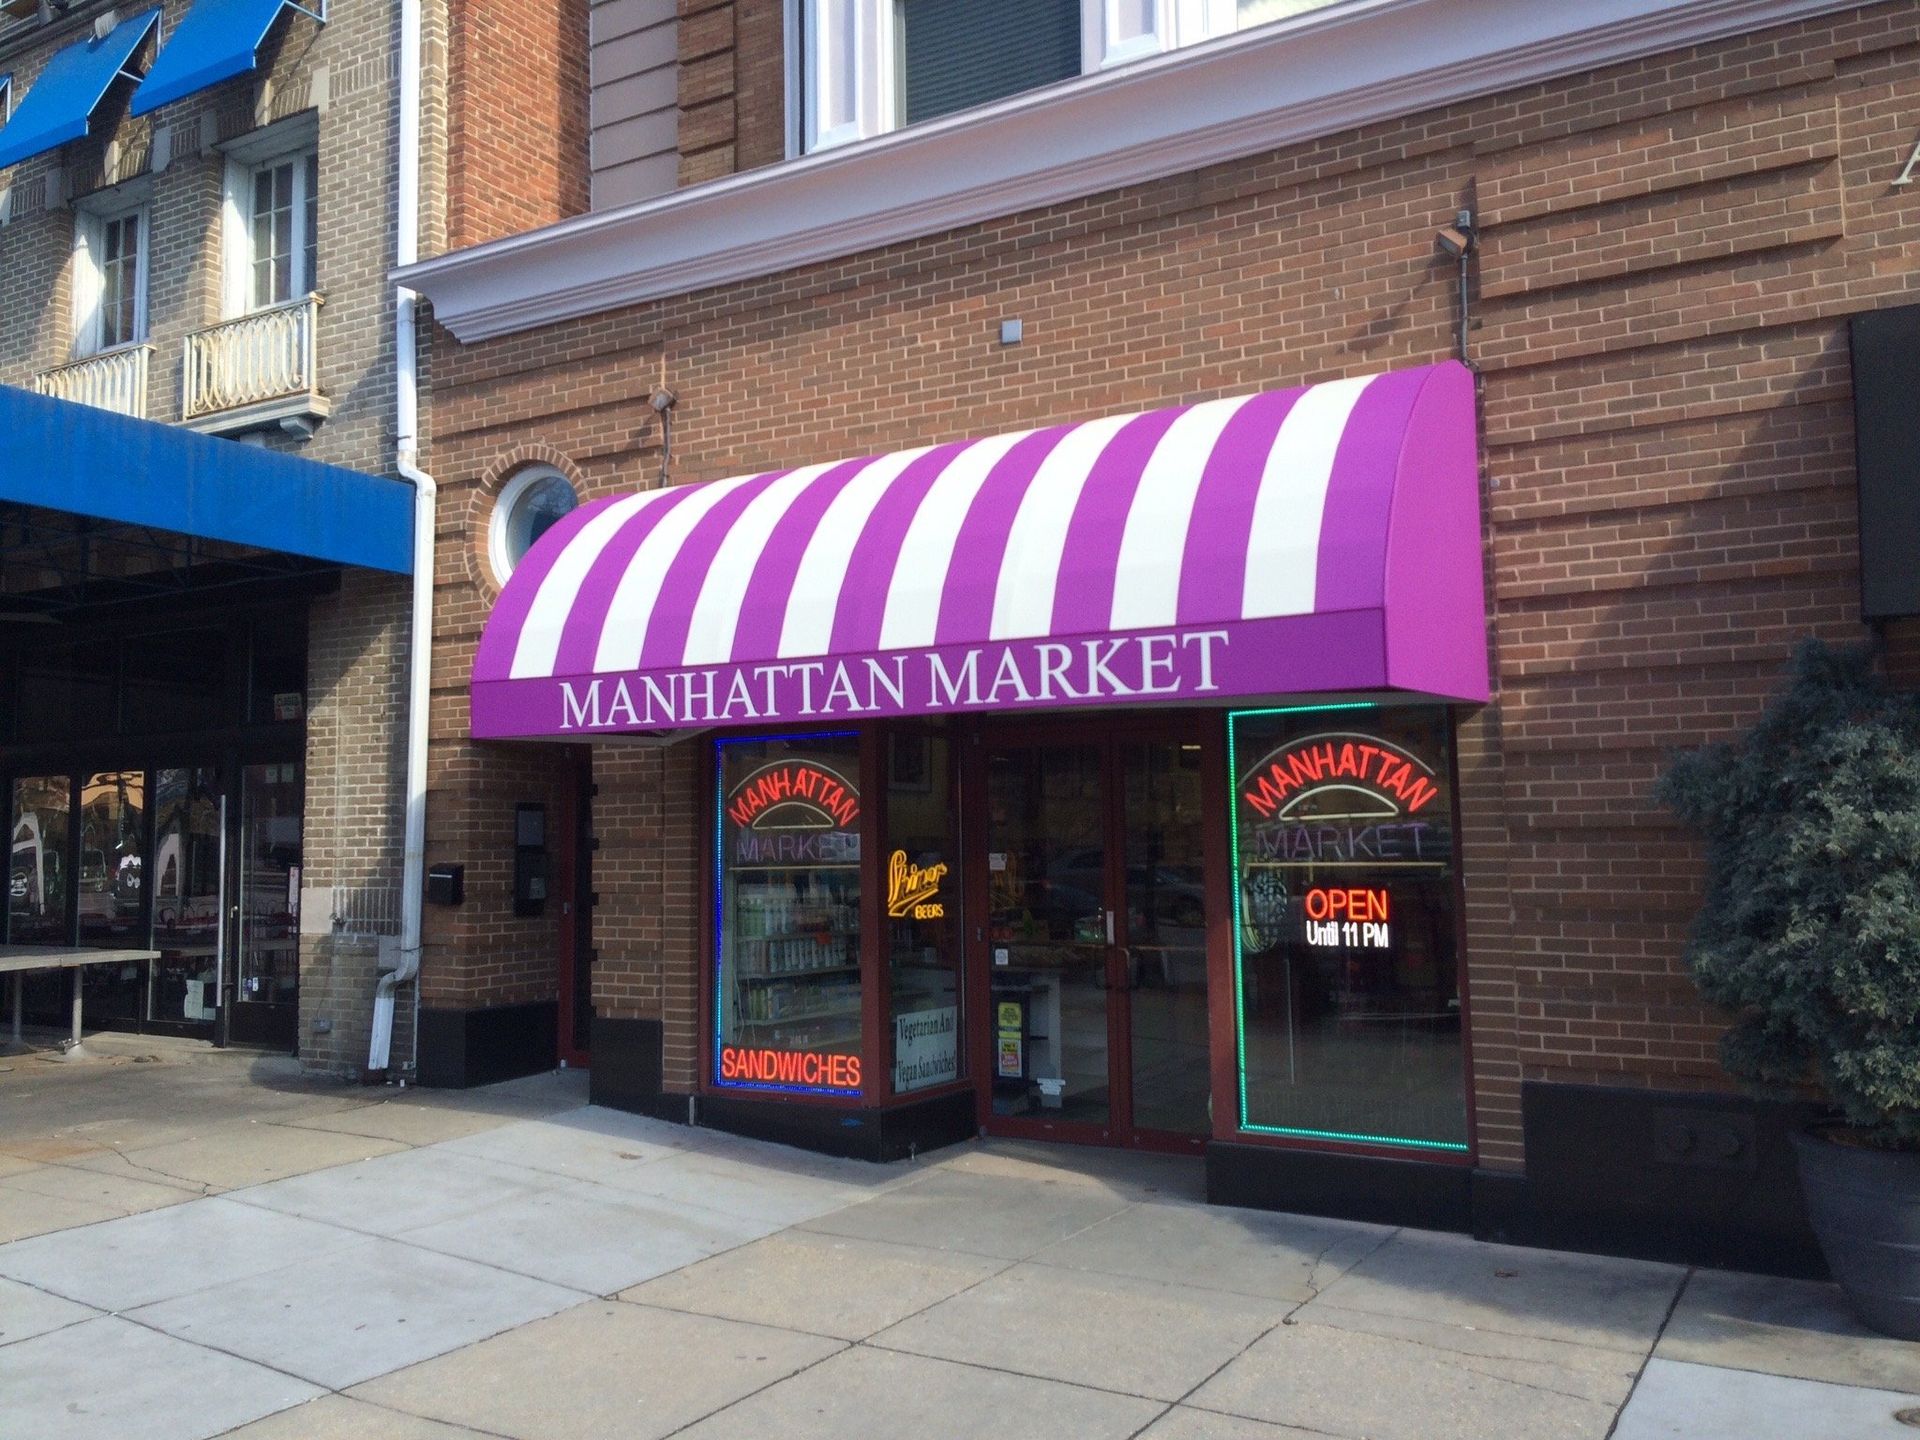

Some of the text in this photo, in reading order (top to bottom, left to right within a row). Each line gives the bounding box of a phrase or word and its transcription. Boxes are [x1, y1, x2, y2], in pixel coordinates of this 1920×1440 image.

[558, 630, 1229, 729] MANHATTAN MARKET
[1244, 742, 1438, 817] MANHATTAN
[728, 768, 860, 828] MANHATTAN
[735, 831, 859, 864] MARKET
[1255, 823, 1429, 860] MARKET
[915, 904, 944, 919] BEERS
[1304, 888, 1388, 921] OPEN
[1305, 921, 1389, 948] Until 11 PM
[899, 1014, 938, 1047] Vegetarian
[722, 1048, 861, 1087] SANDWICHES
[898, 1060, 917, 1090] Vegan
